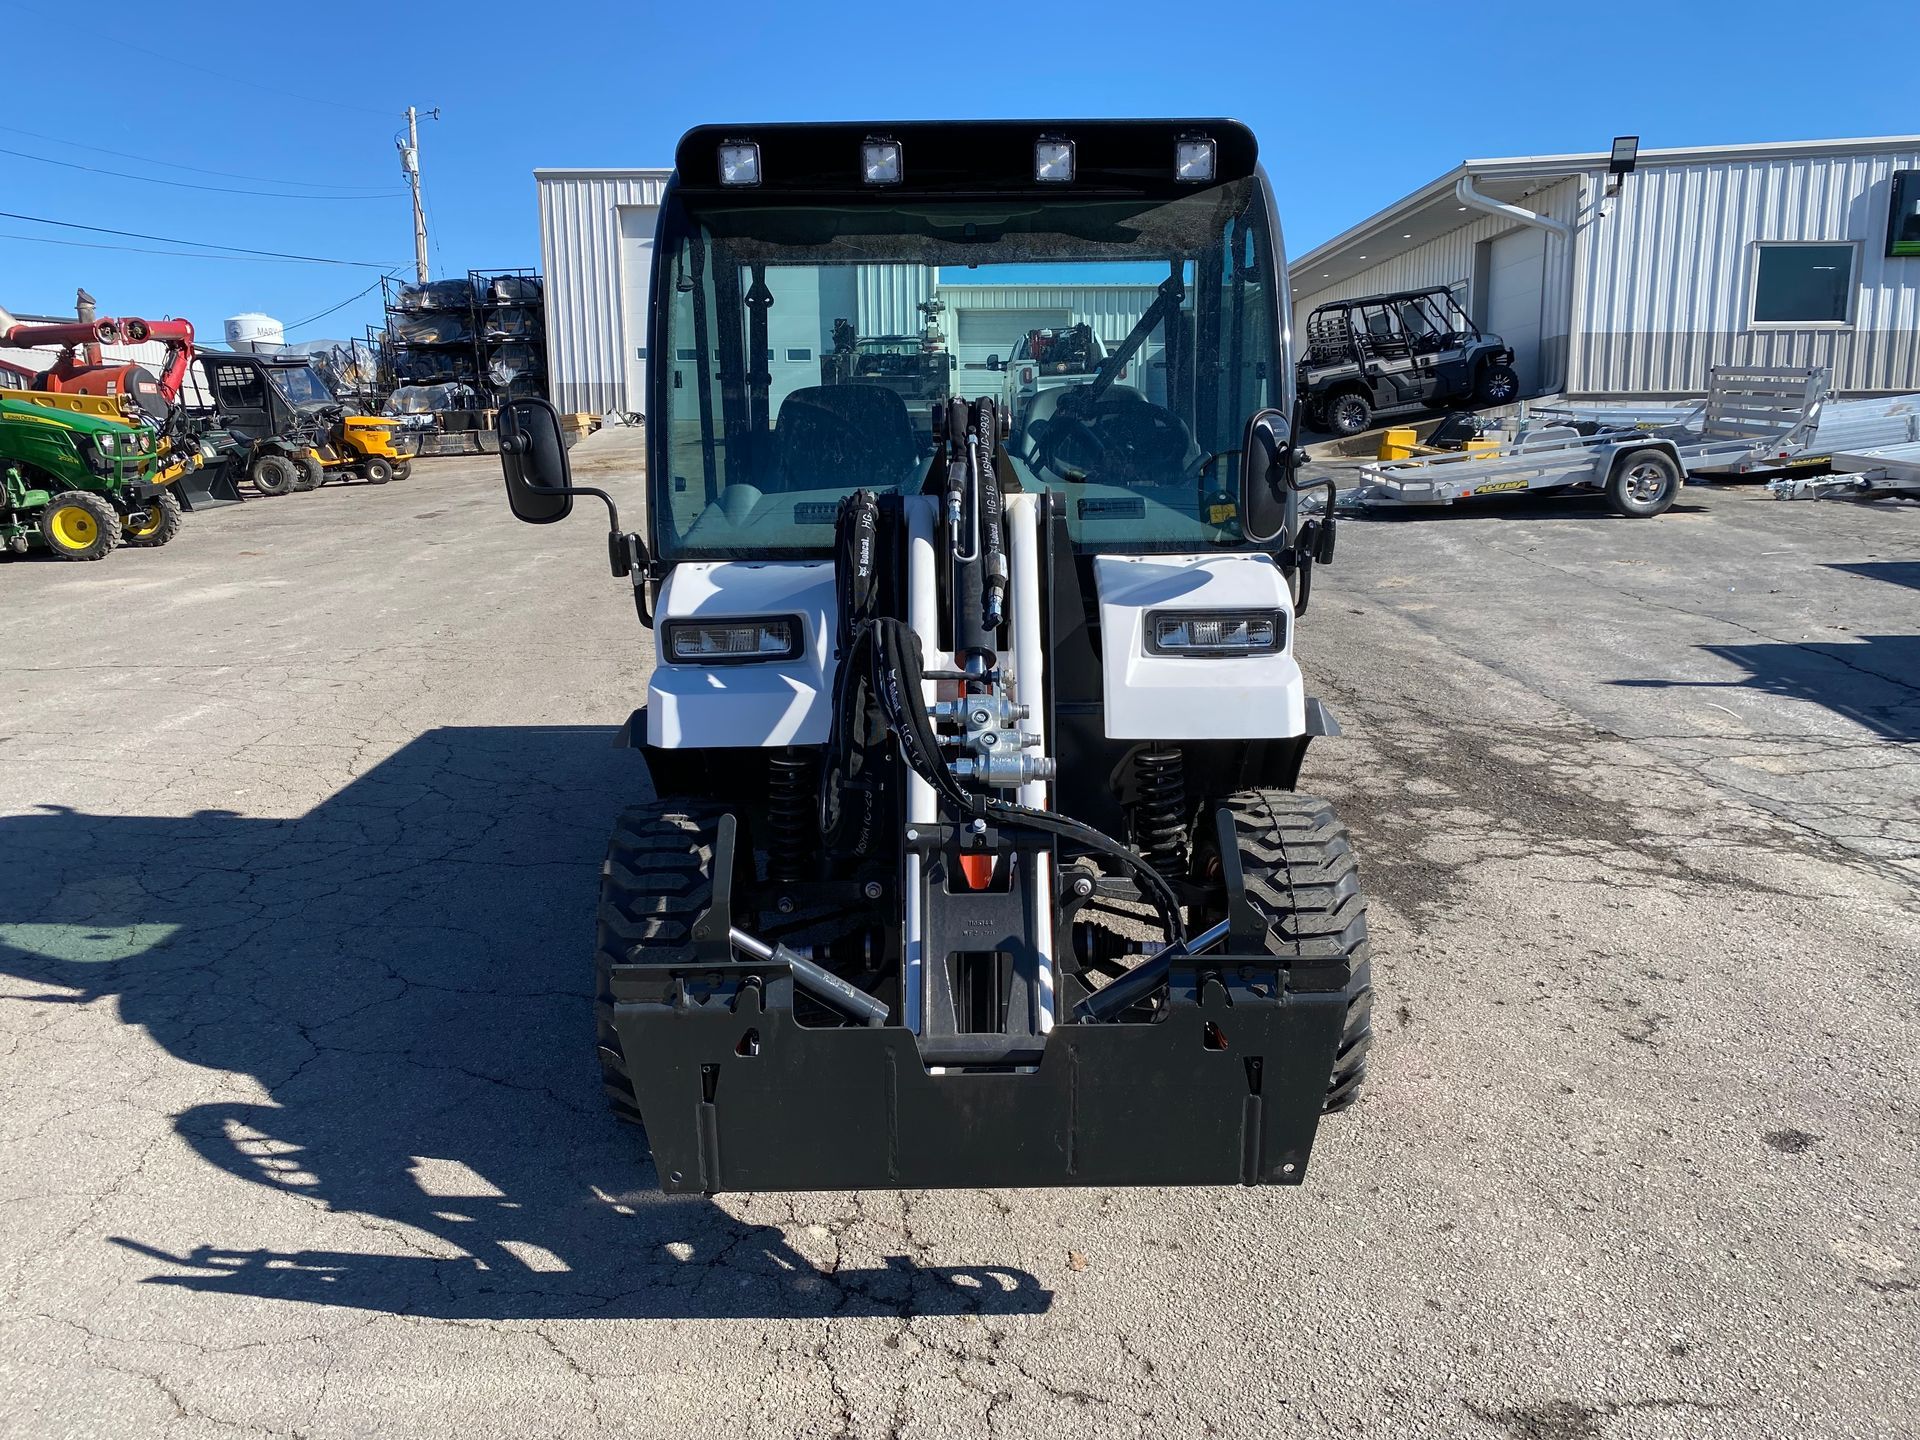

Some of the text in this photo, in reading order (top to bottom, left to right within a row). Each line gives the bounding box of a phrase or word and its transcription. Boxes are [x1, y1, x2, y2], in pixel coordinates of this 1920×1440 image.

[980, 409, 990, 449] IC-293/1
[987, 485, 998, 514] HG-16
[1474, 480, 1529, 494] ALUMA
[989, 522, 999, 545] Bobcat
[860, 537, 870, 565] Bobcat
[888, 681, 902, 715] Bobcat
[864, 771, 873, 826] IC-29/1
